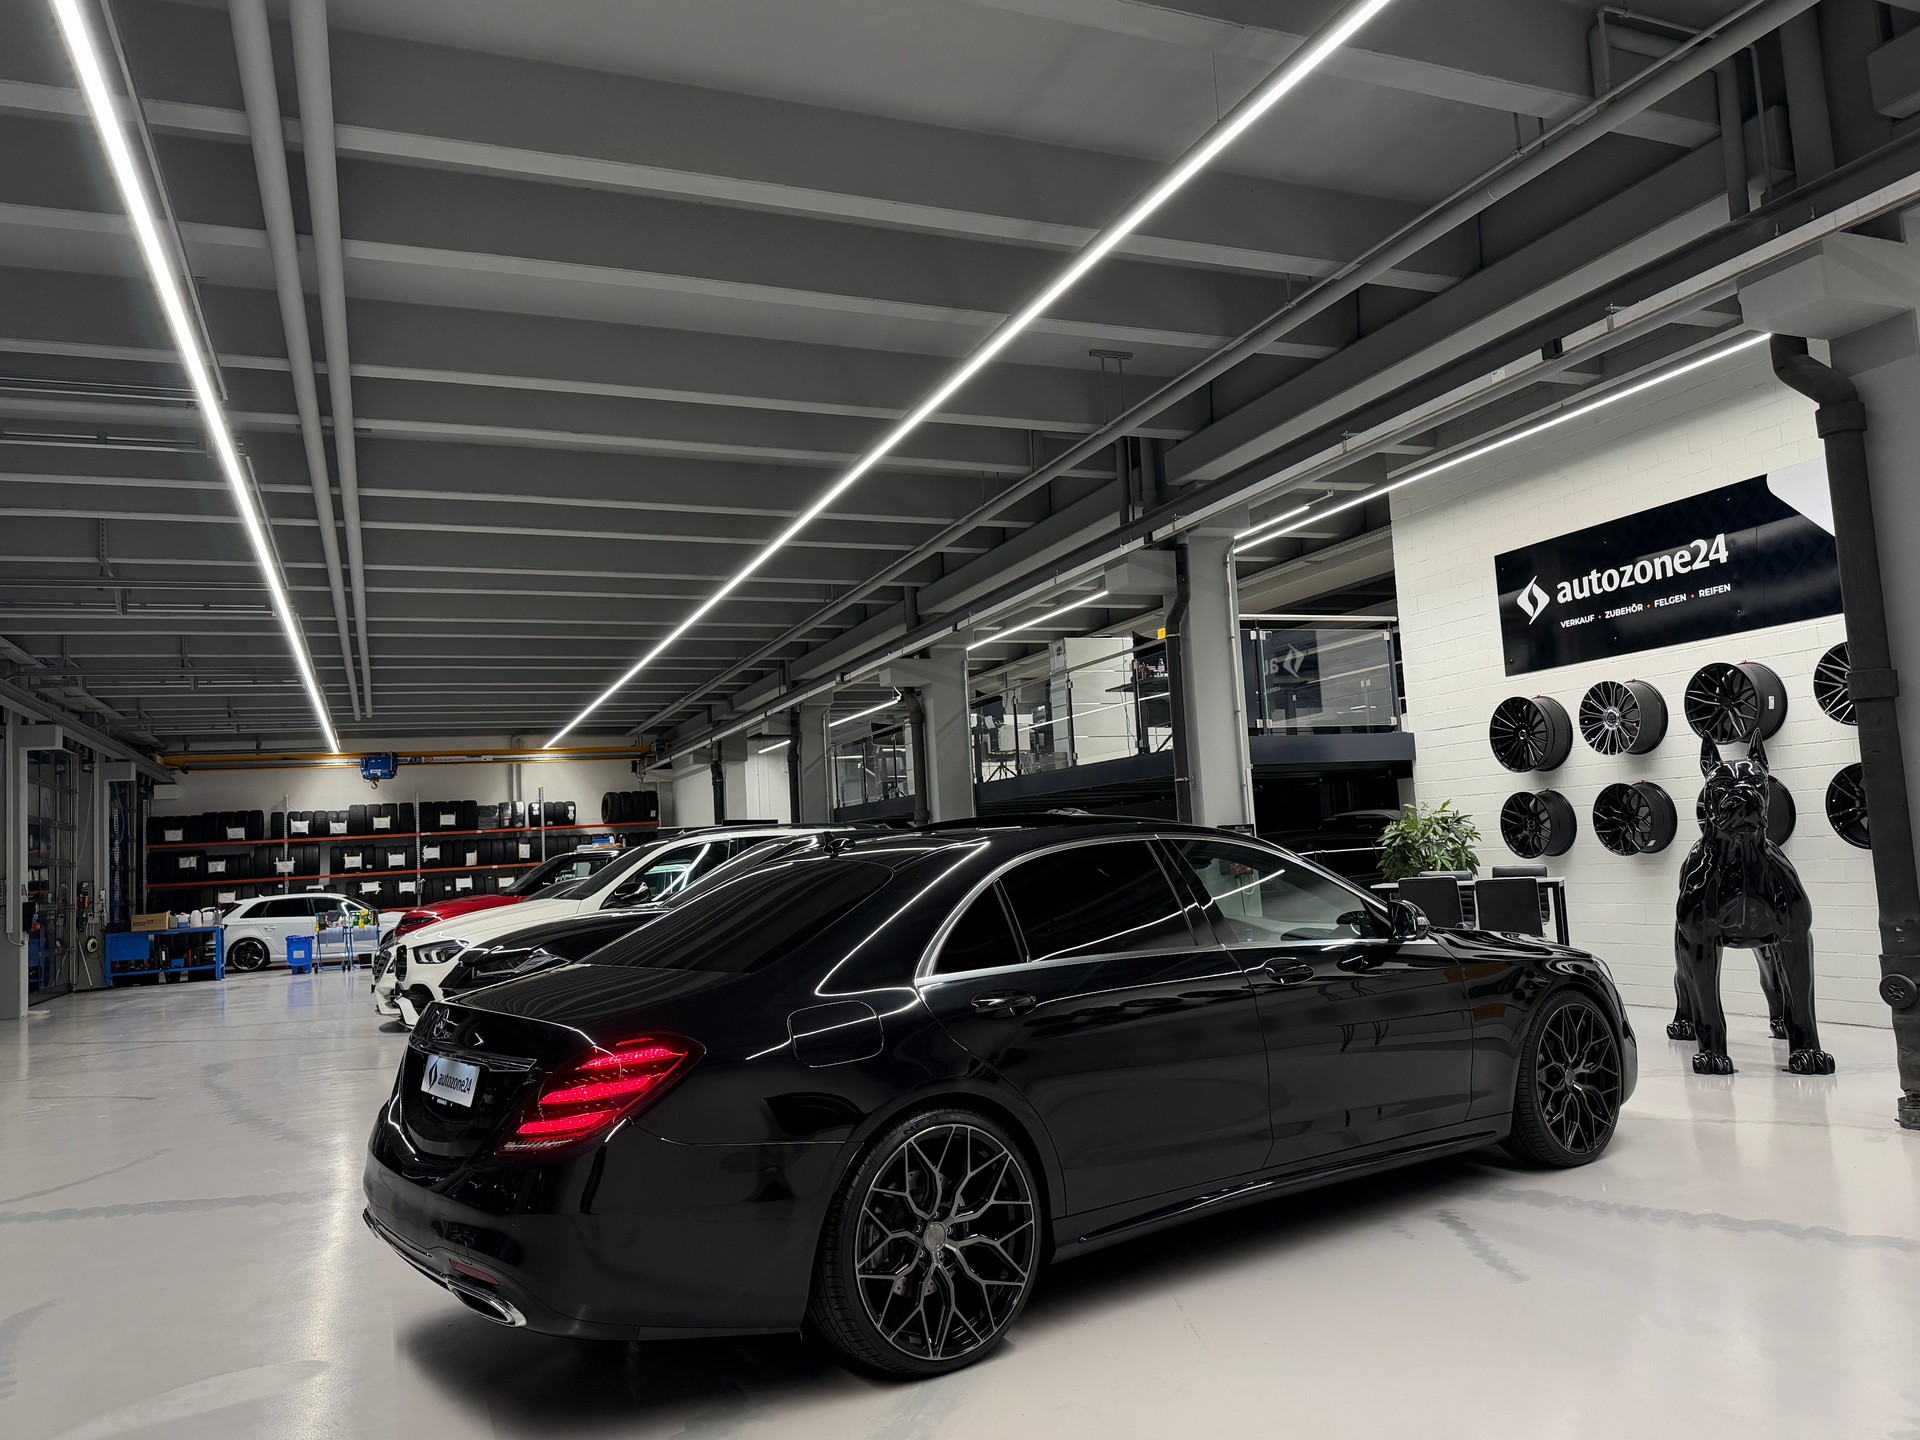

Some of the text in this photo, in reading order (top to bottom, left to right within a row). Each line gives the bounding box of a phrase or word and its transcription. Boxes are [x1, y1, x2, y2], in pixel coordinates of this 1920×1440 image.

[1557, 533, 1729, 603] autozone24
[1560, 583, 1731, 628] VERKAUF ZUBEHÖR FELGEN REIFEN
[437, 1073, 473, 1094] autozone24
